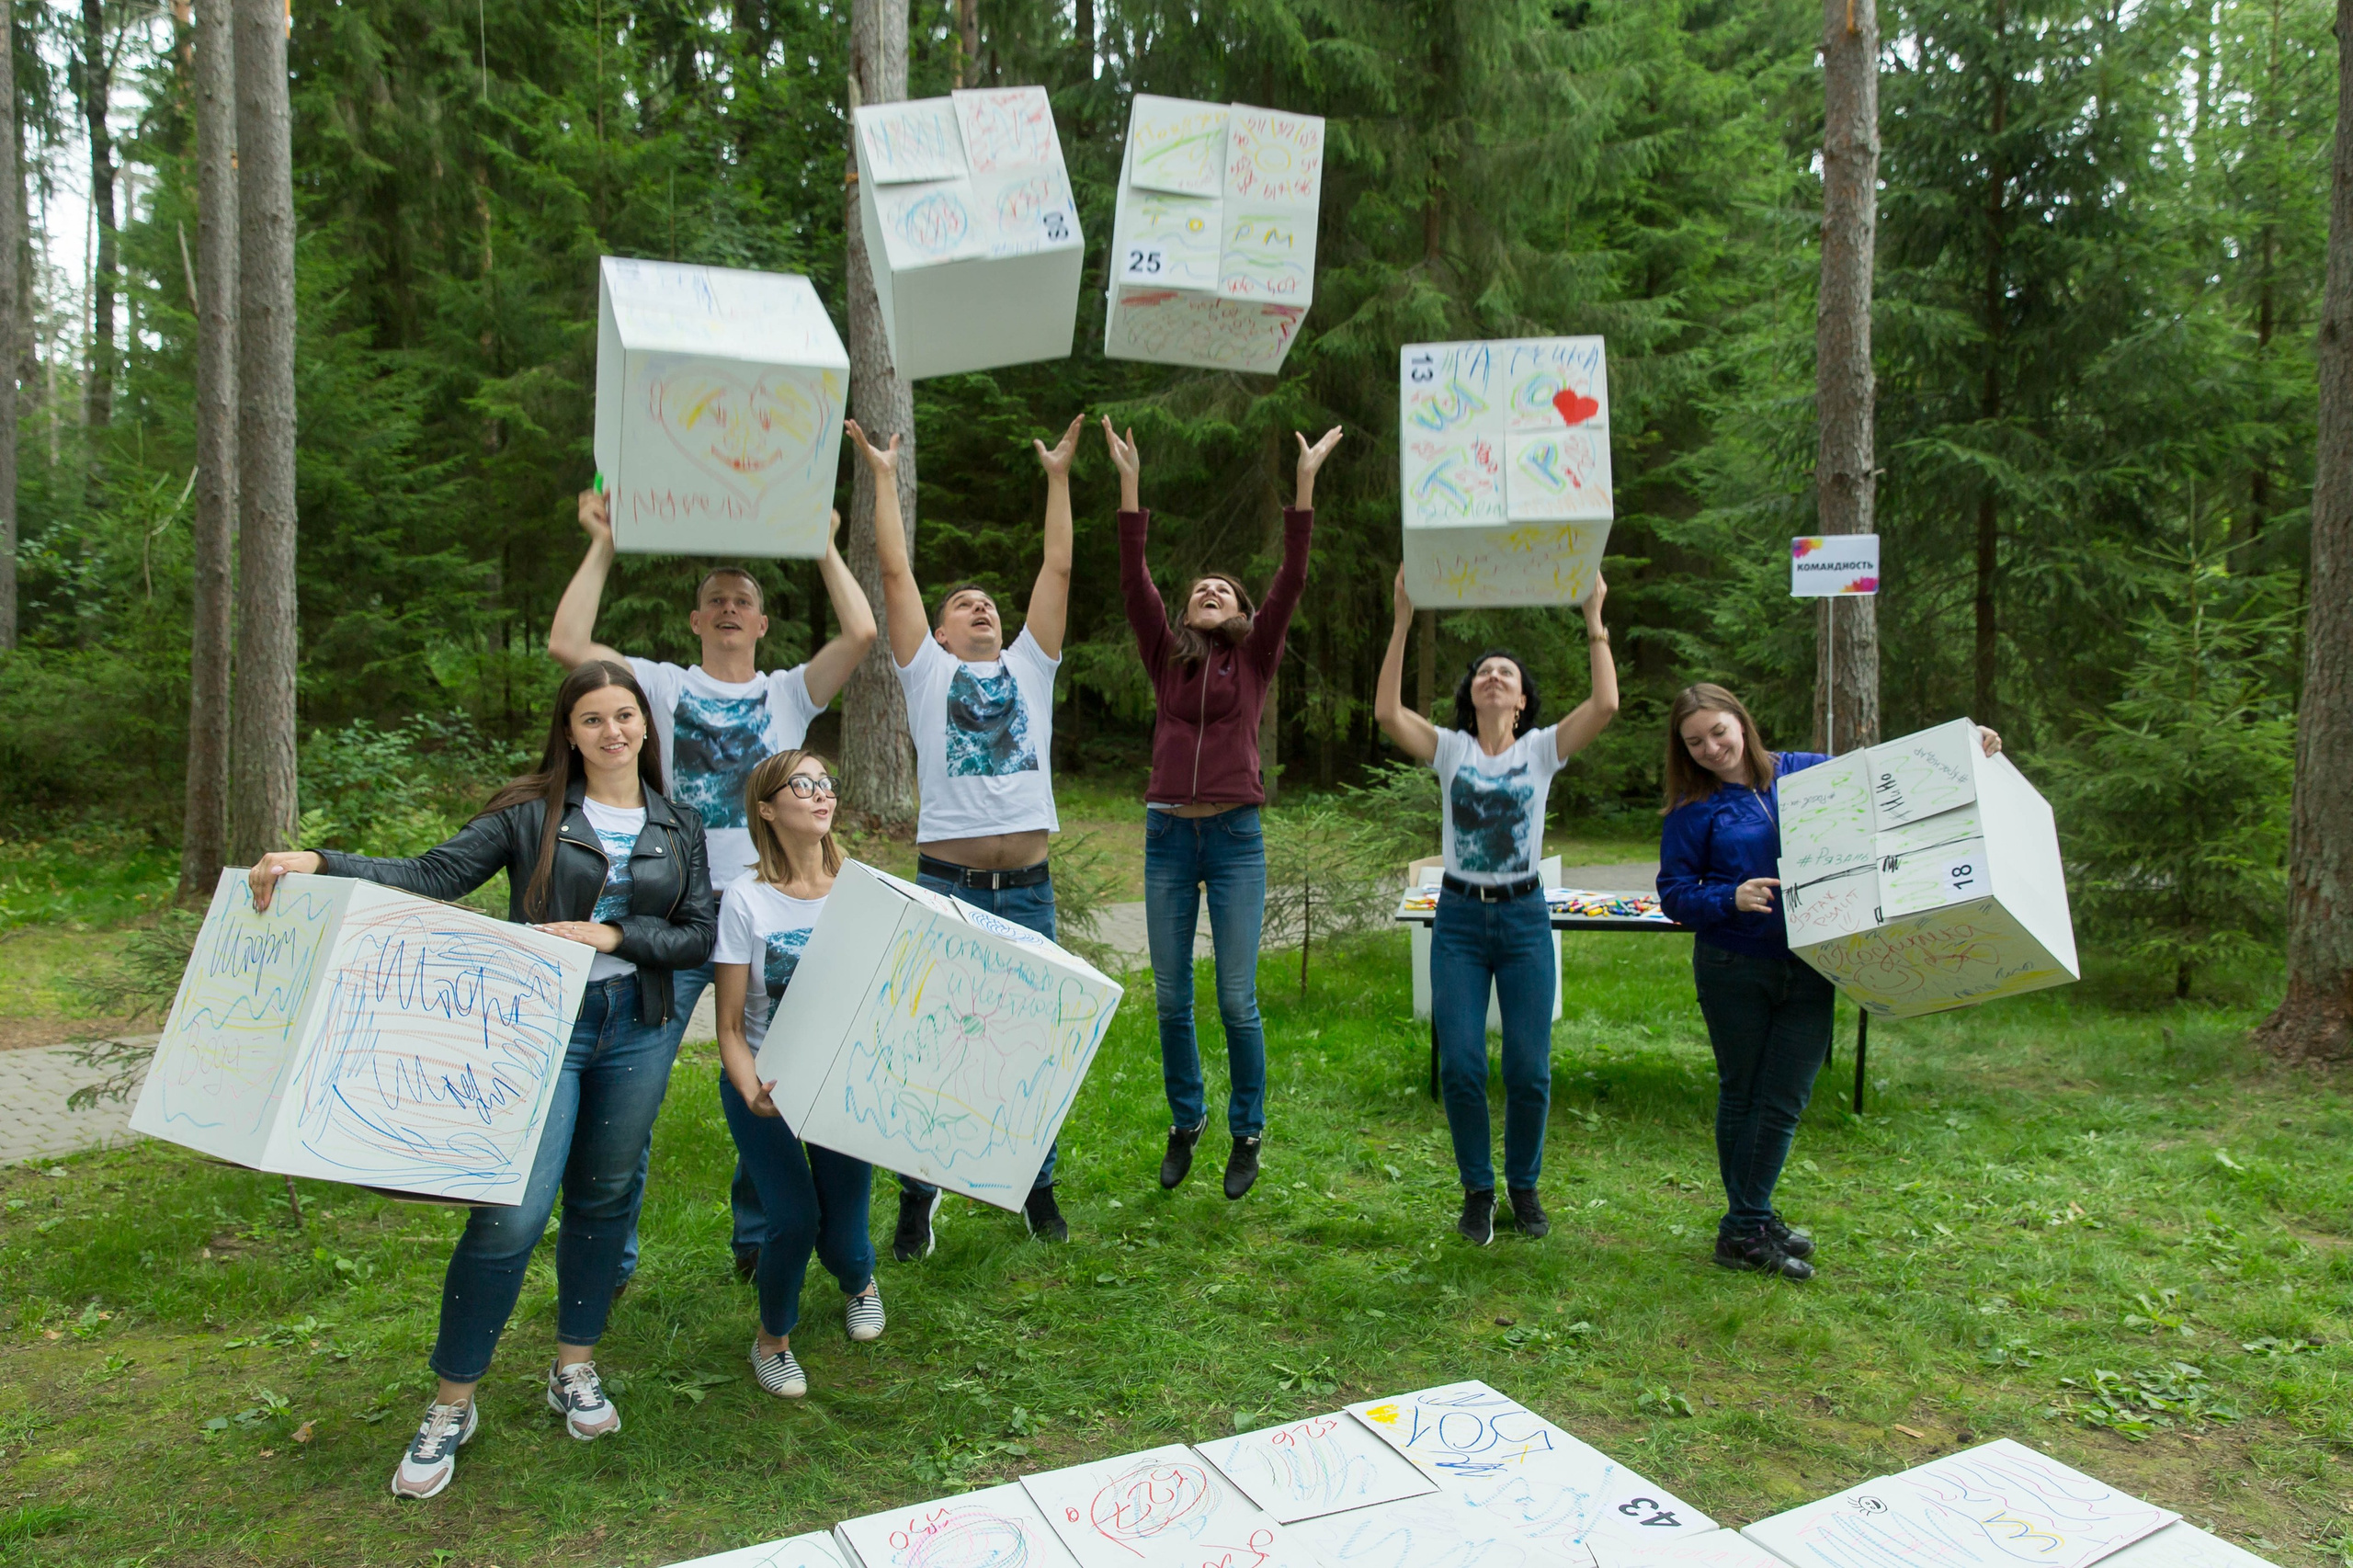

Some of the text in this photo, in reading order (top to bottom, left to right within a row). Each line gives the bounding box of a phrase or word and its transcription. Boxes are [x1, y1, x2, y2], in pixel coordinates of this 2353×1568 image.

[1128, 250, 1162, 274] 25
[1409, 352, 1434, 385] 13
[1797, 561, 1873, 572] КОМАНДНОСТЬ
[1950, 864, 1973, 891] 18
[1617, 1496, 1683, 1529] 43
